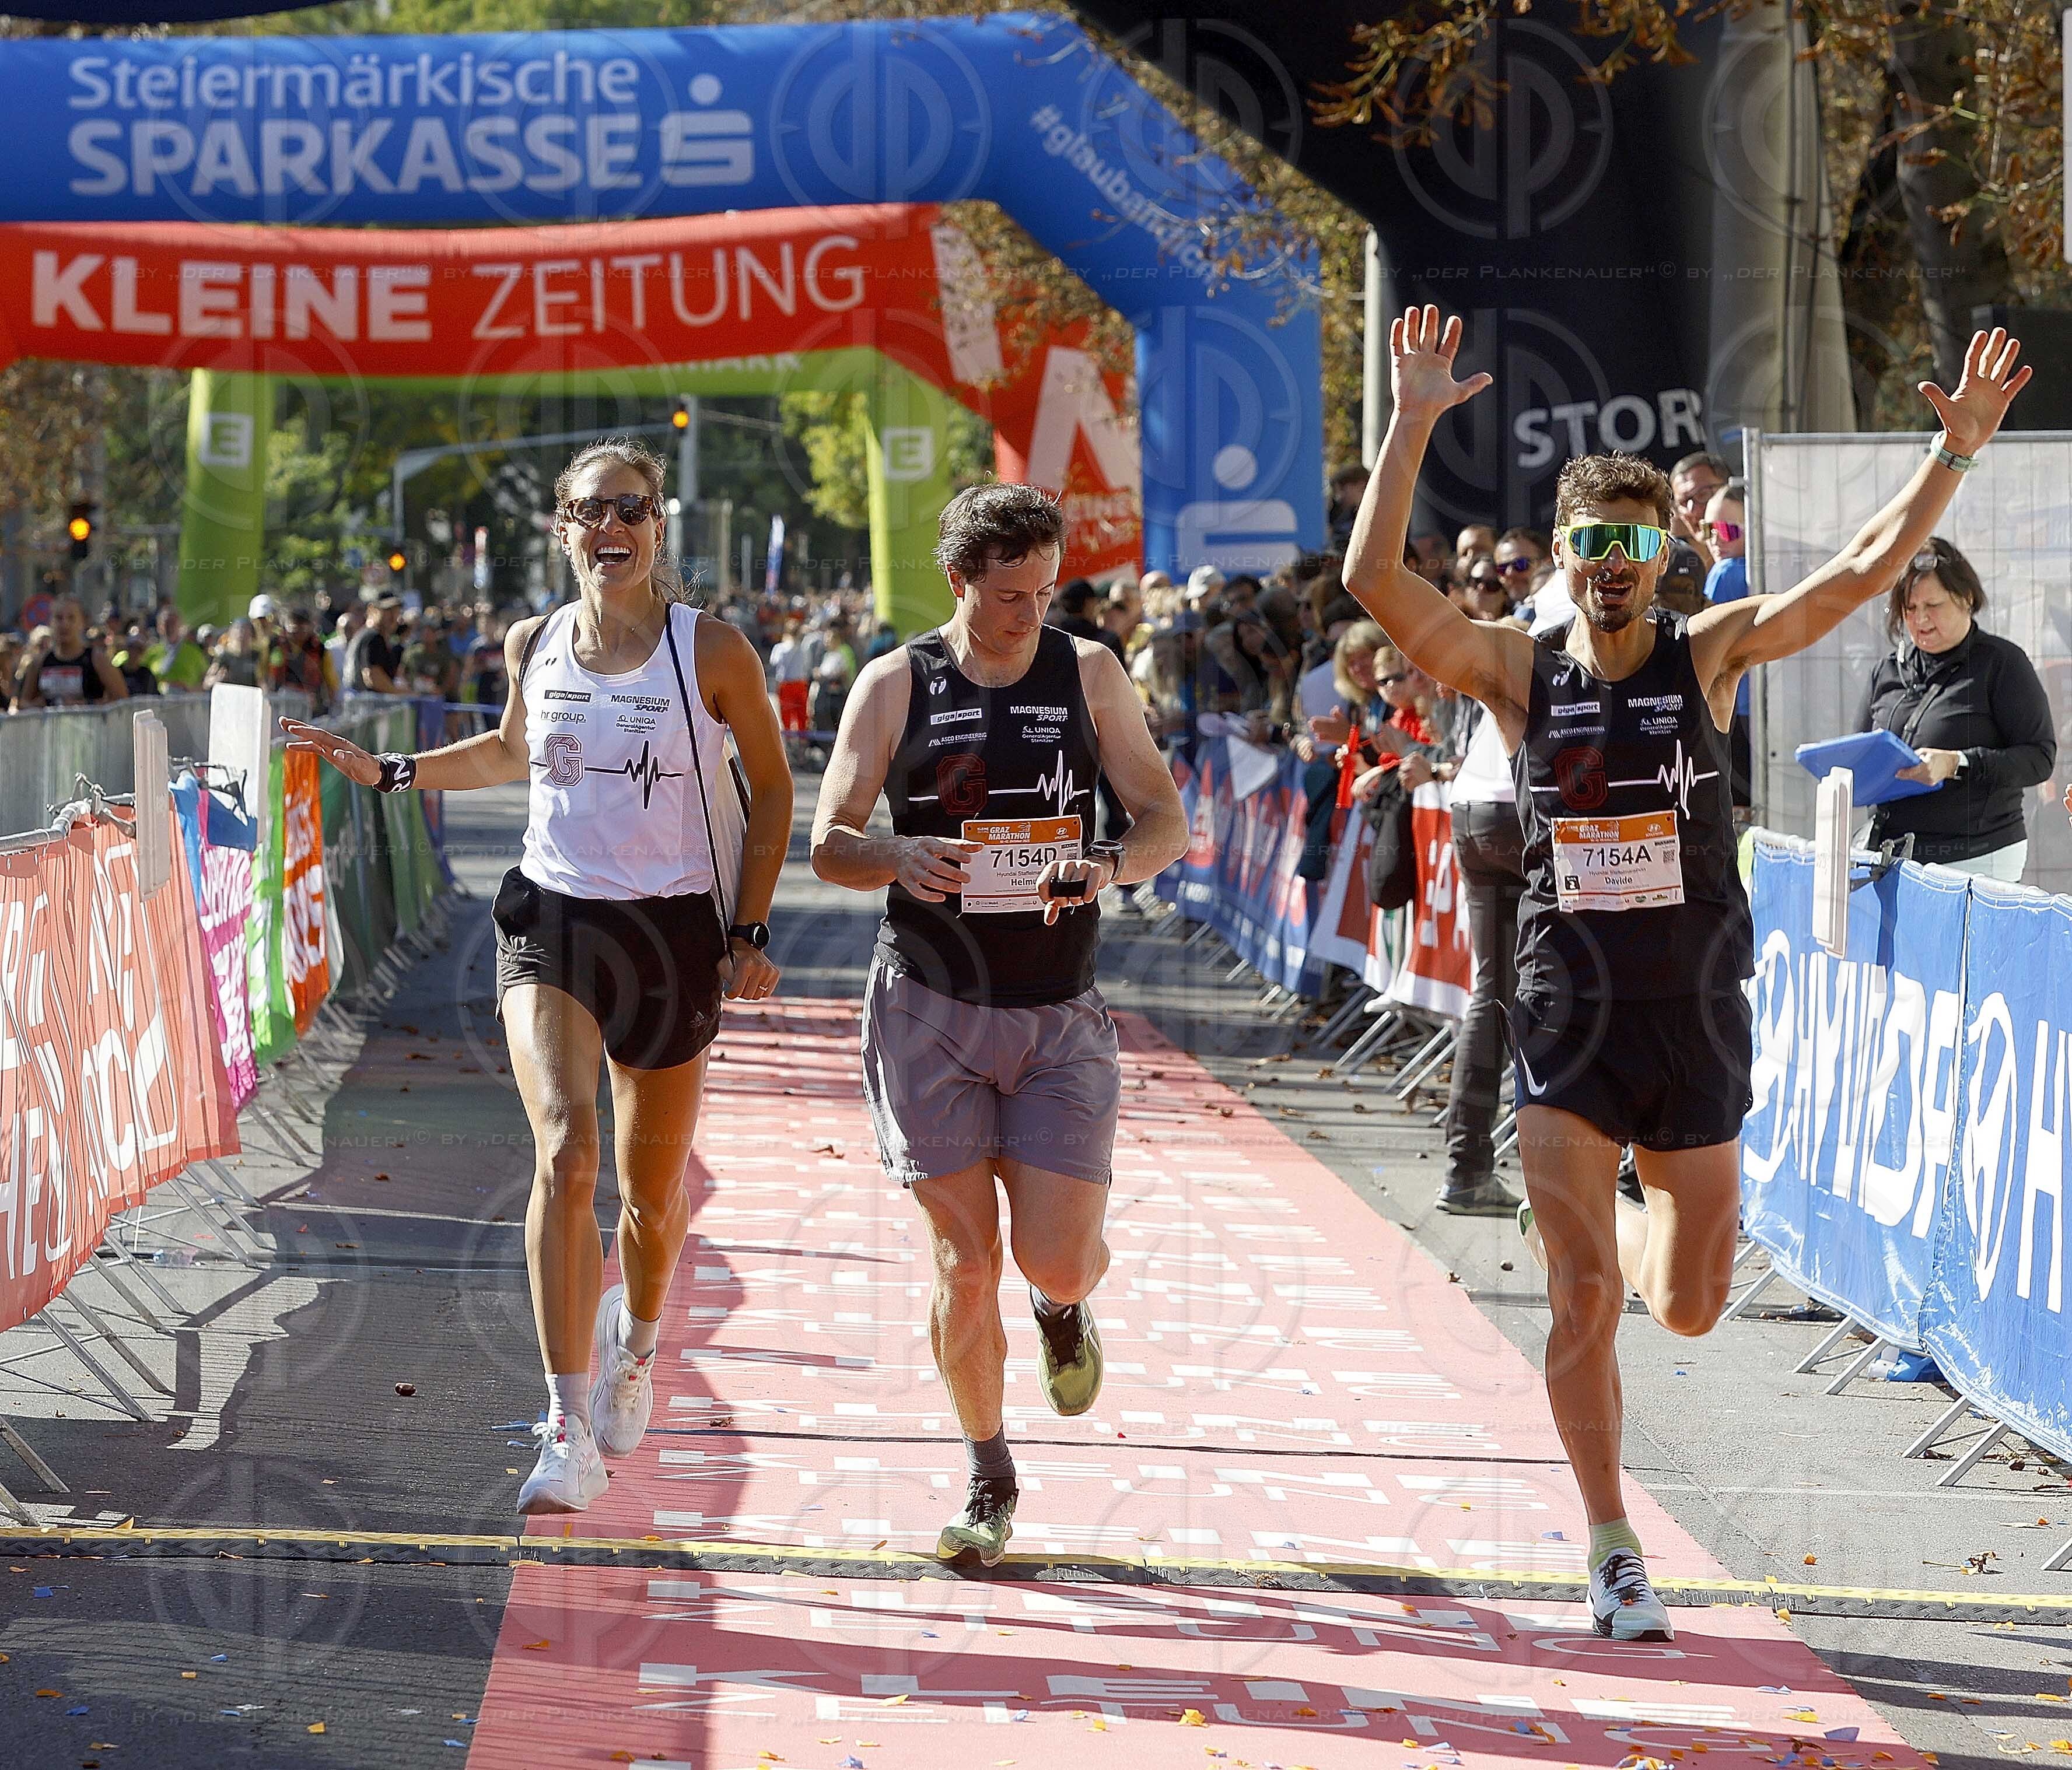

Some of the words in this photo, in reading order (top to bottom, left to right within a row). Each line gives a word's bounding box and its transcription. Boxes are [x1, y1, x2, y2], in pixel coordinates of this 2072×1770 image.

[68, 51, 639, 110] Steiermärkische
[68, 113, 643, 196] SPARKASSE
[31, 250, 432, 342] KLEINE
[471, 236, 865, 340] ZEITUNG
[611, 695, 670, 706] MAGNESIUM
[1628, 695, 1683, 708] MAGNESIUM
[634, 705, 669, 713] SPORT
[1010, 706, 1068, 716] MAGNESIUM
[630, 716, 656, 725] UNIQA
[991, 847, 1057, 868] 7154D
[1583, 846, 1652, 867] 7154A
[1605, 876, 1633, 885] Davide
